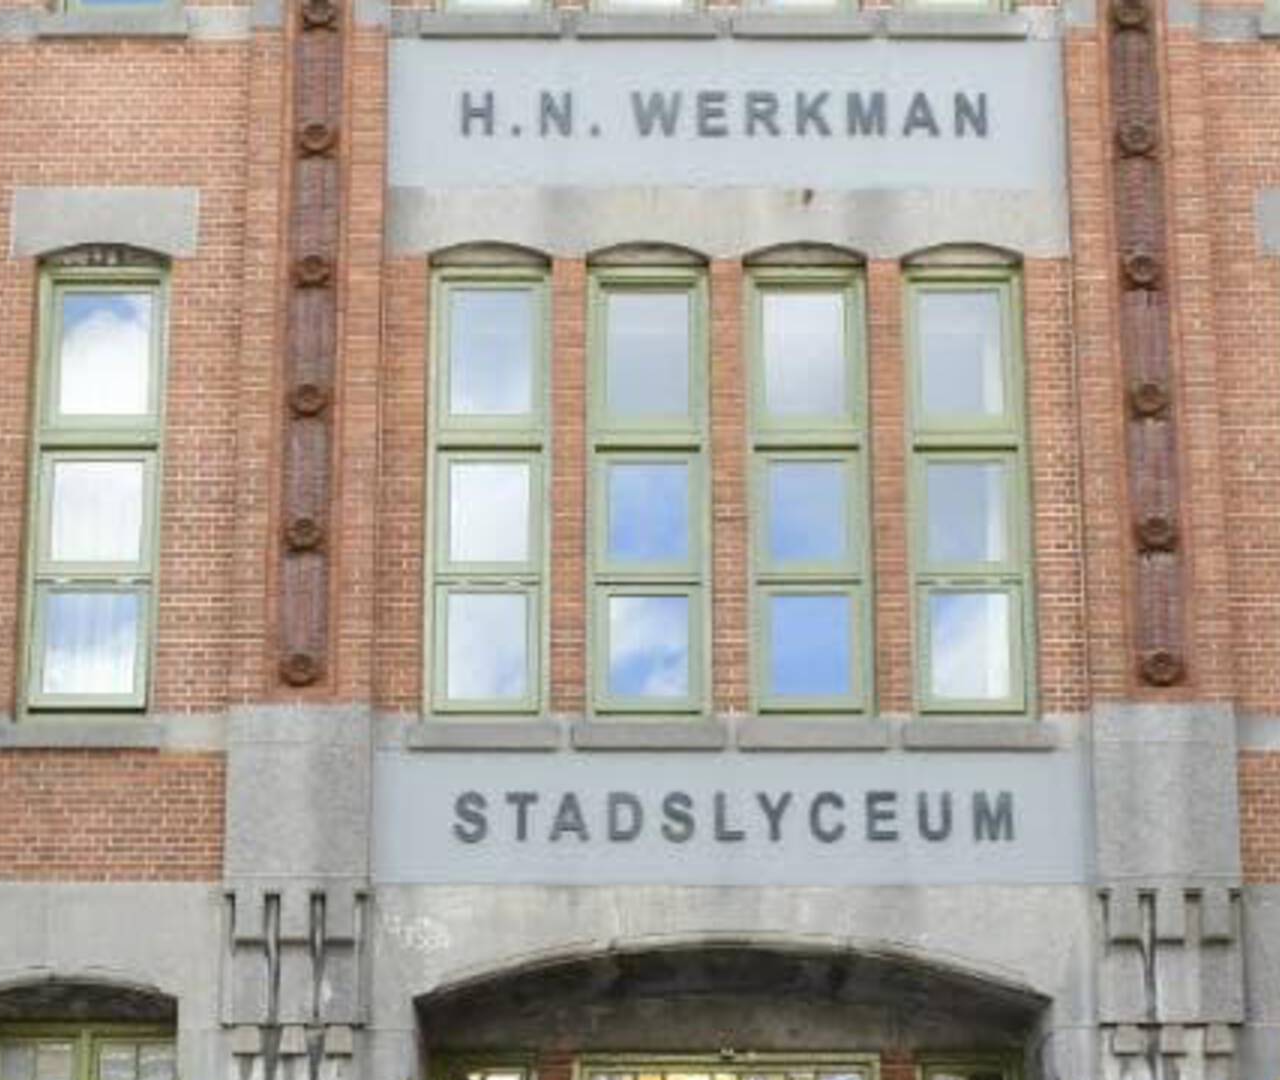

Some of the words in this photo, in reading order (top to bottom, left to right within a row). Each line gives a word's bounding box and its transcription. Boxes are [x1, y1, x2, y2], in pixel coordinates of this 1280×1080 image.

[461, 91, 600, 137] H.N.
[632, 91, 989, 138] WERKMAN
[453, 790, 1016, 845] STADSLYCEUM
